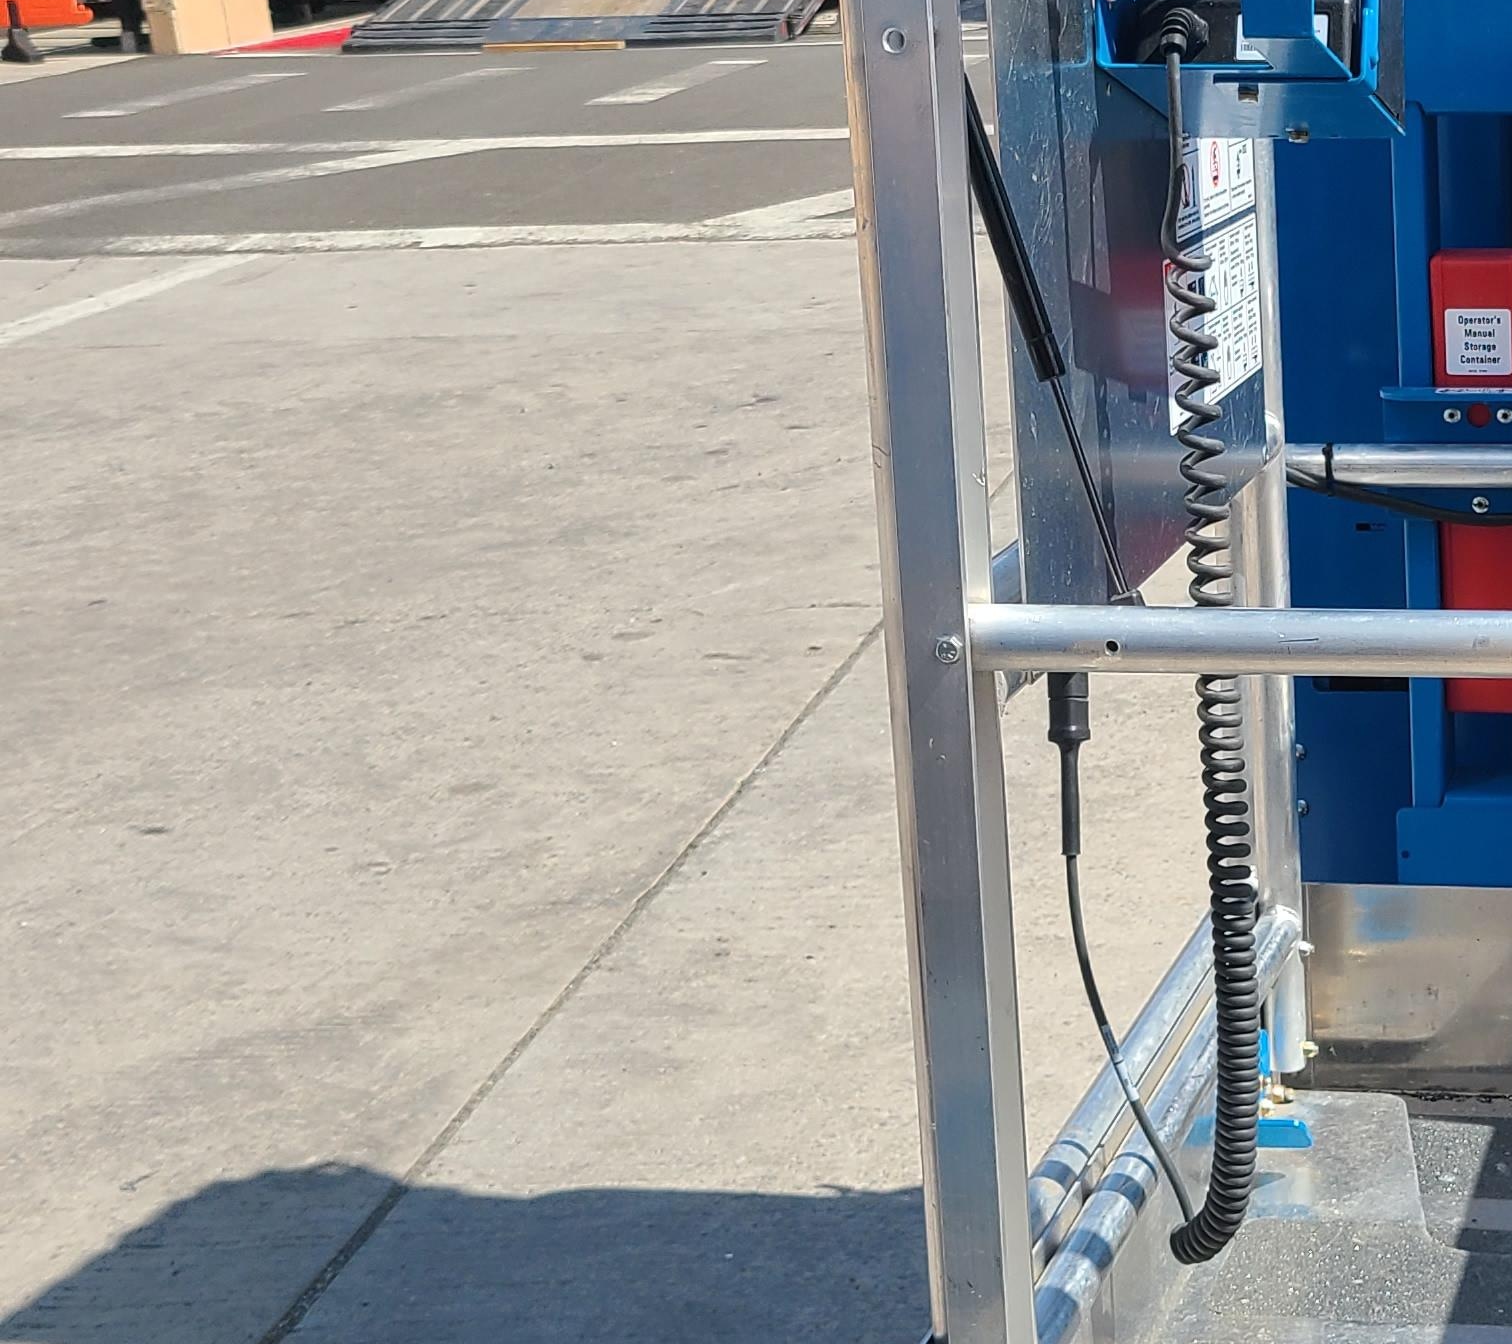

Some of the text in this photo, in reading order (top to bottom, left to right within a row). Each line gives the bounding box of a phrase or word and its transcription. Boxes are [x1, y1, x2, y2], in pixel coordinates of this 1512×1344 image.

[1457, 314, 1502, 326] Operator's
[1464, 328, 1496, 338] Manual
[1463, 341, 1497, 353] Storage
[1459, 354, 1502, 364] Container
